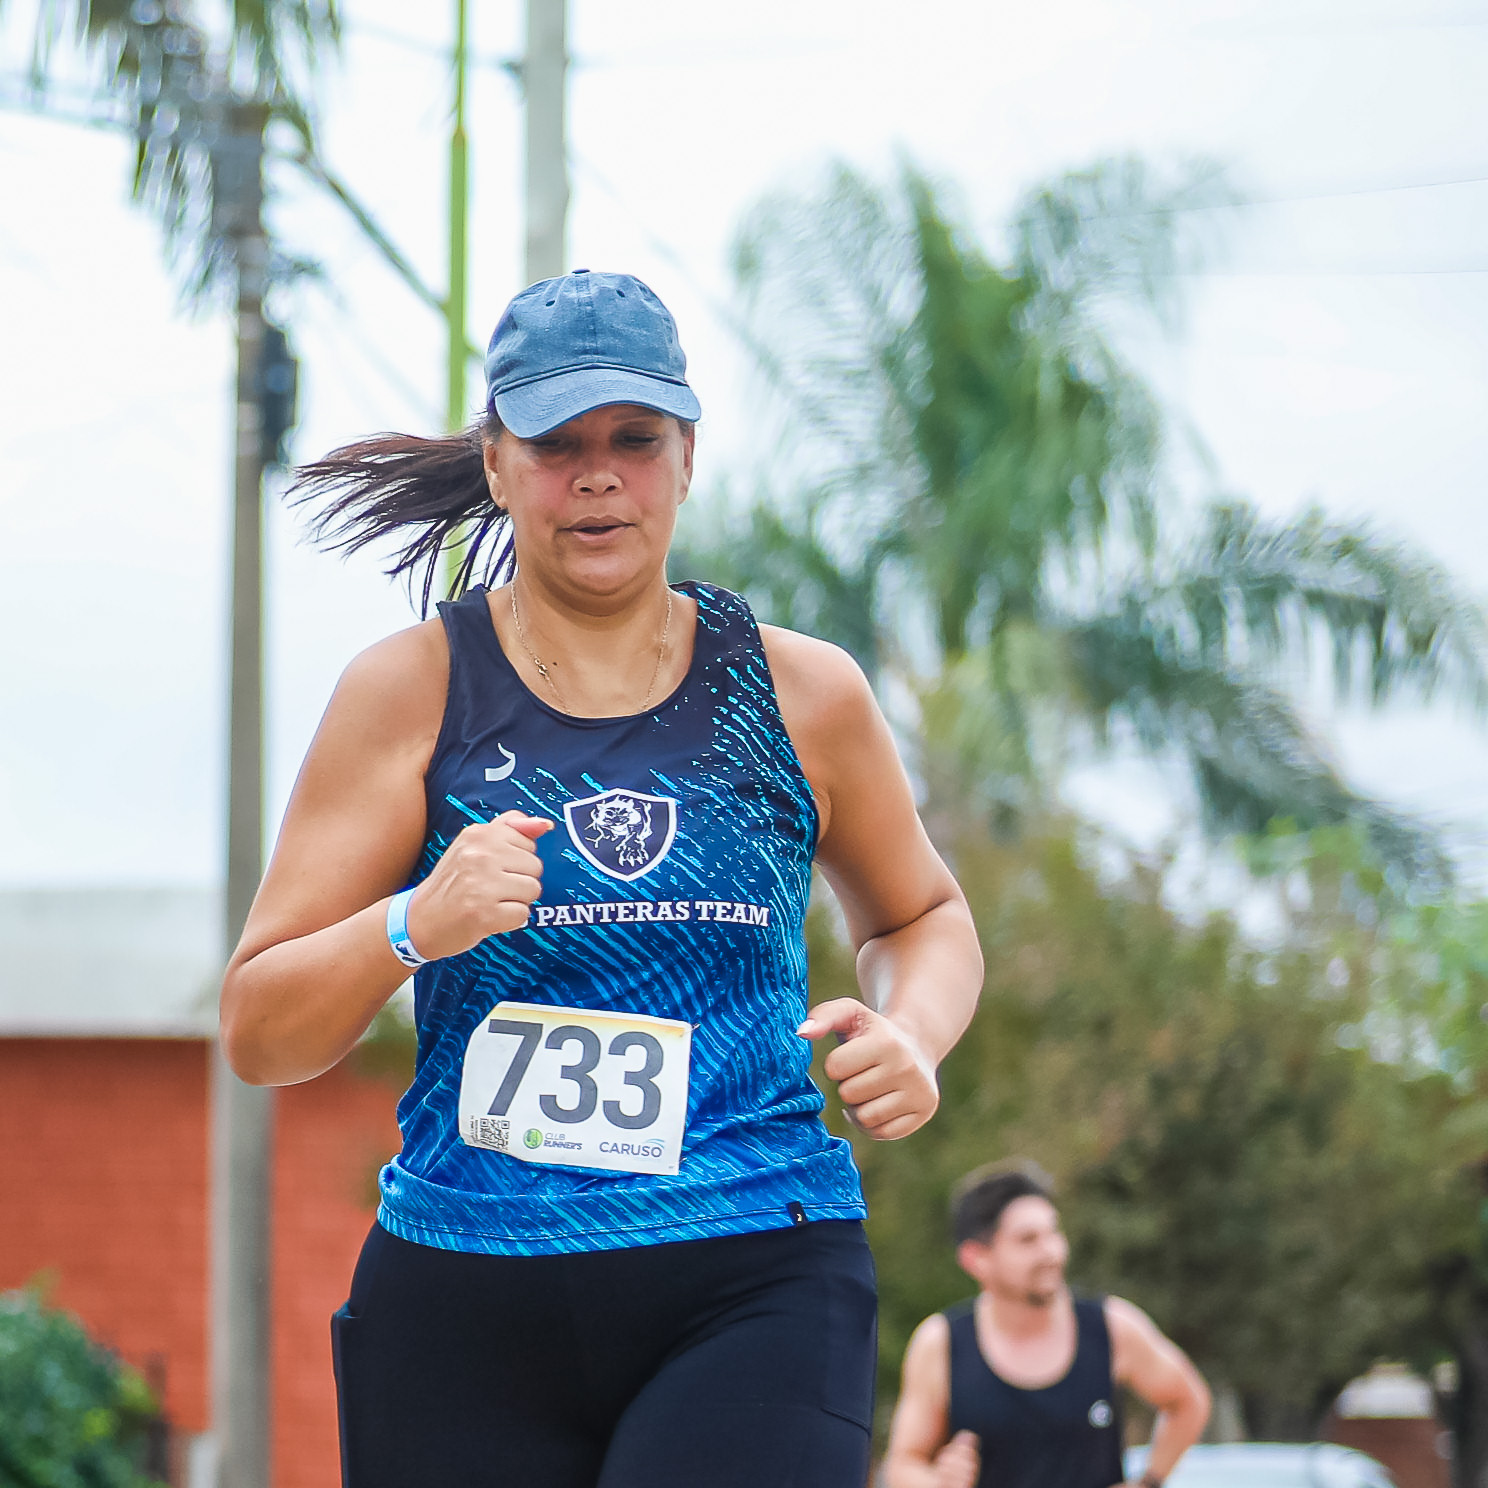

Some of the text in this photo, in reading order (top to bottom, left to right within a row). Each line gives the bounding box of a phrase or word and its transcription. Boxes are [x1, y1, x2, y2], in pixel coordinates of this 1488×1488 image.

[536, 901, 770, 927] PANTERAS TEAM
[485, 1018, 664, 1130] 733
[599, 1142, 662, 1158] CARUSO
